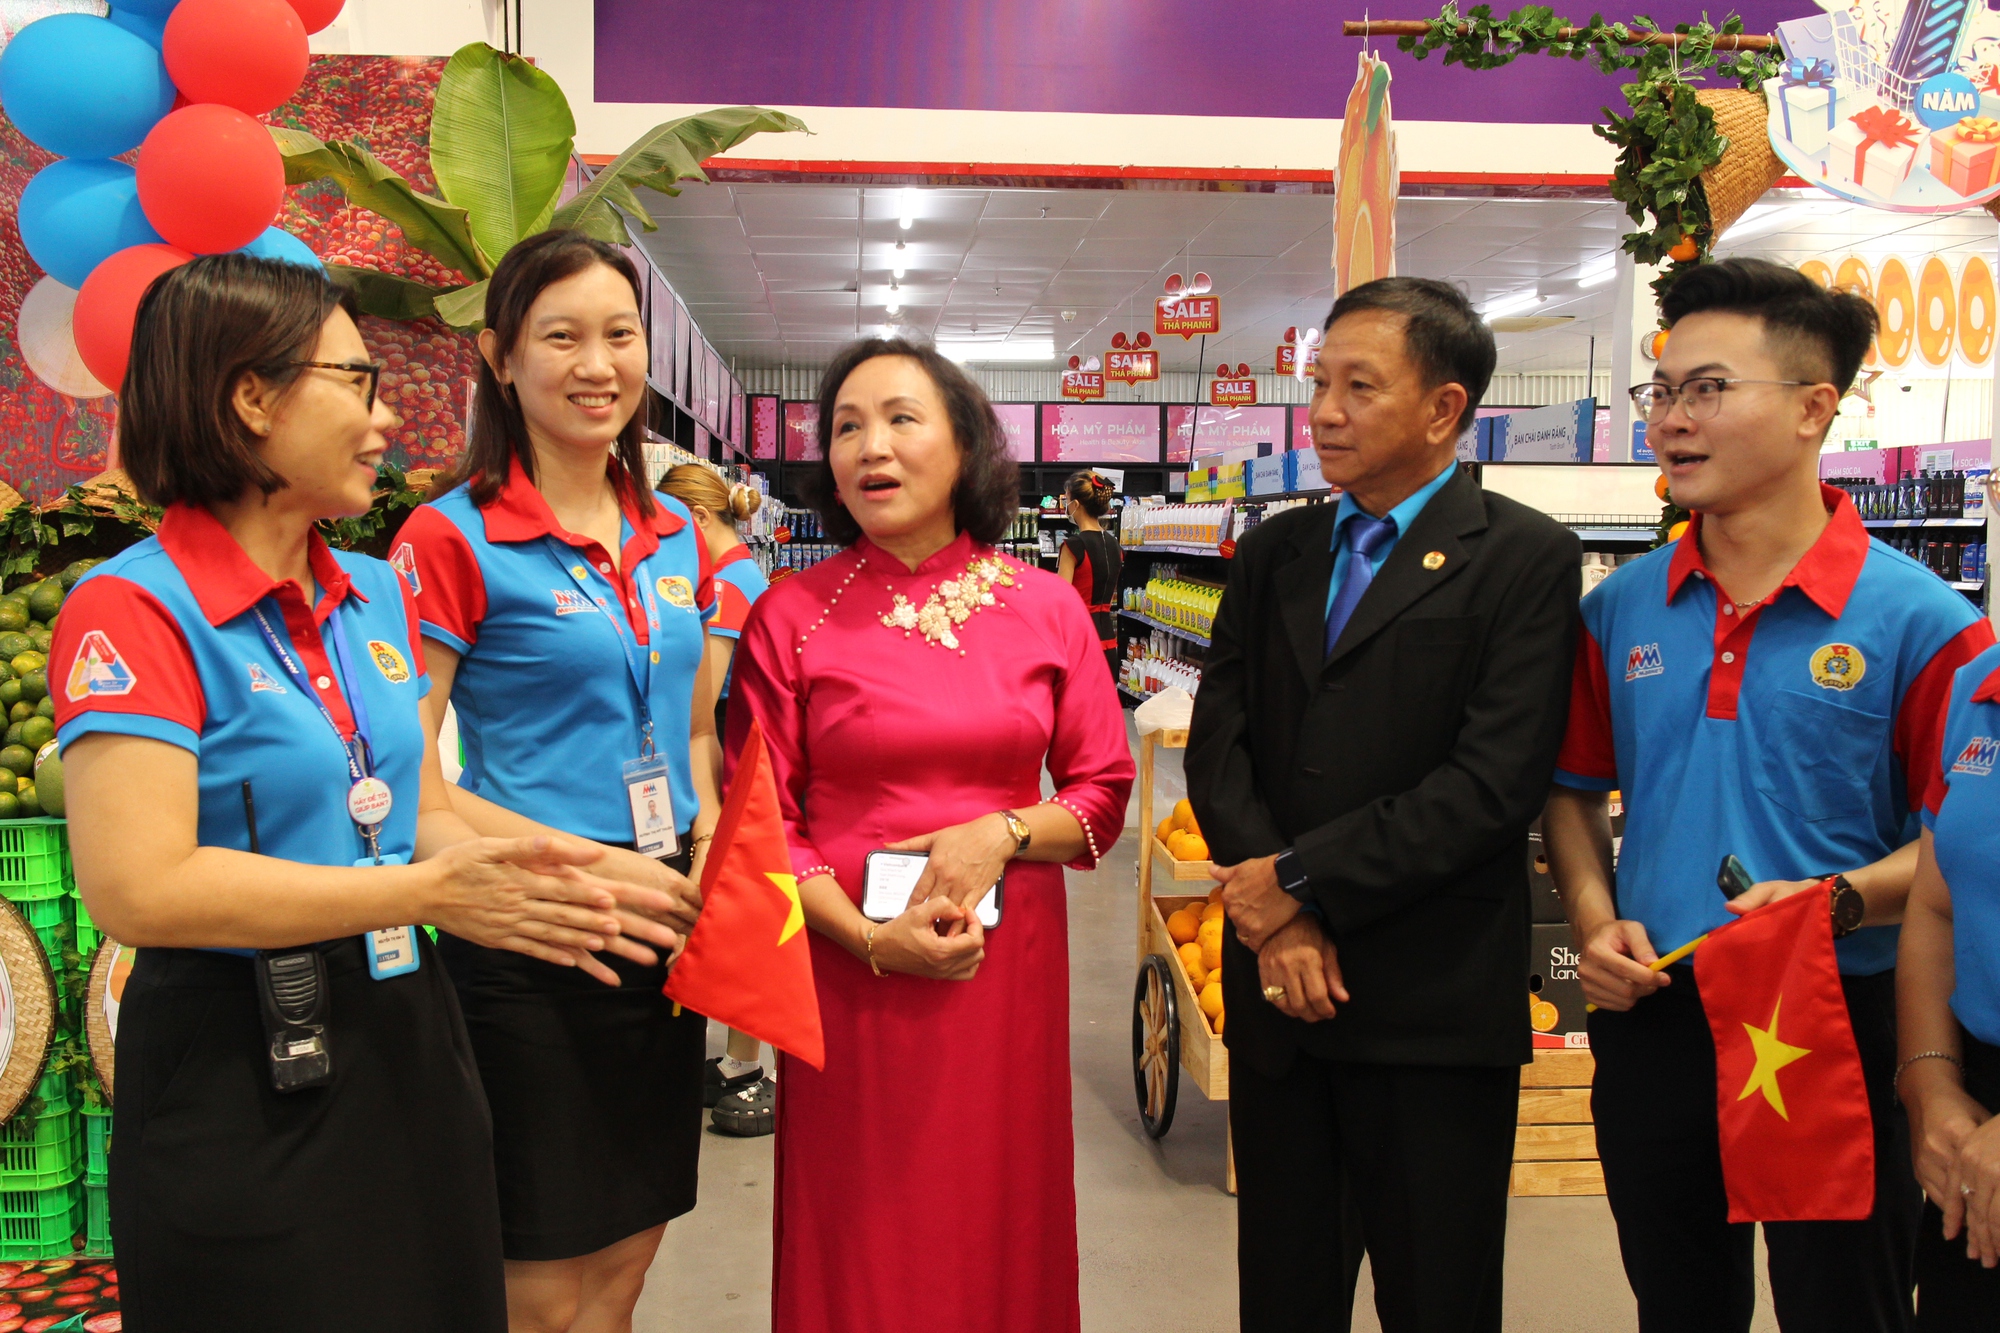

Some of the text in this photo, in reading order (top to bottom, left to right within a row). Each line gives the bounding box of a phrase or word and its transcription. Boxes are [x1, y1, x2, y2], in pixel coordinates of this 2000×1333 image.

[1923, 88, 1976, 112] NĂM
[1163, 301, 1212, 319] SALE
[1163, 320, 1211, 330] THẢ PHANH
[1110, 354, 1152, 369] SALE
[1110, 369, 1126, 377] THẢ
[1067, 374, 1100, 387] SALE
[1067, 386, 1100, 395] THẢ PHANH
[1216, 382, 1251, 394] SALE
[1216, 394, 1229, 402] THẢ
[1083, 422, 1103, 435] MỸ
[1108, 420, 1146, 435] PHẨM
[1208, 423, 1229, 437] MỸ
[1233, 421, 1271, 437] PHẨM
[1514, 426, 1566, 446] BÀN CHẢI ĐÁNH RĂNG
[1960, 457, 1973, 468] SÓC
[1974, 457, 1985, 467] DA
[1842, 466, 1853, 476] SÓC
[1853, 466, 1862, 475] DA
[1550, 946, 1581, 967] She
[1550, 966, 1580, 980] Lan
[1571, 1034, 1590, 1045] Cit
